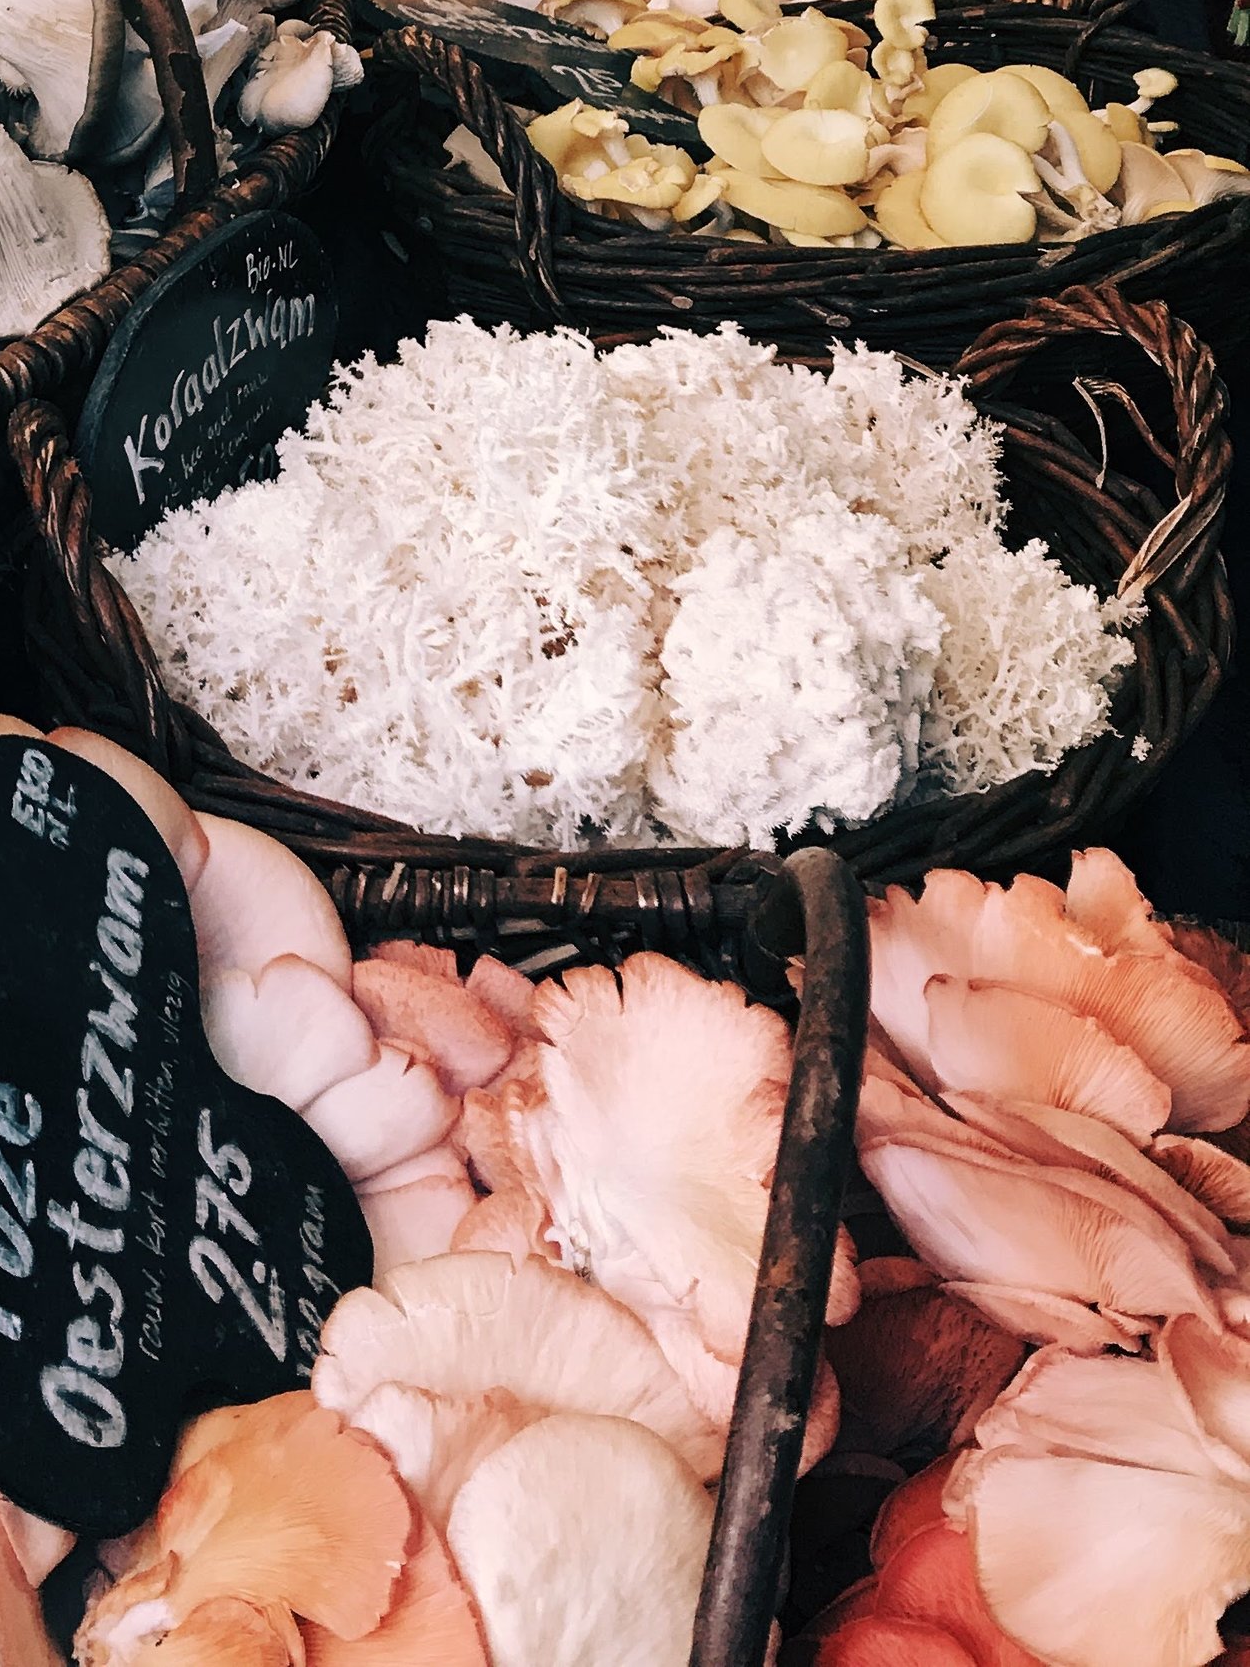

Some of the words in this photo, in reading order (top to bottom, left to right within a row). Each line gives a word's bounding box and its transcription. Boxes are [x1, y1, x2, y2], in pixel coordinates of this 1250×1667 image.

[124, 288, 316, 505] Koraalzwam
[11, 749, 52, 836] EKO
[39, 847, 151, 1448] Oesterzwam
[136, 1187, 167, 1256] kort
